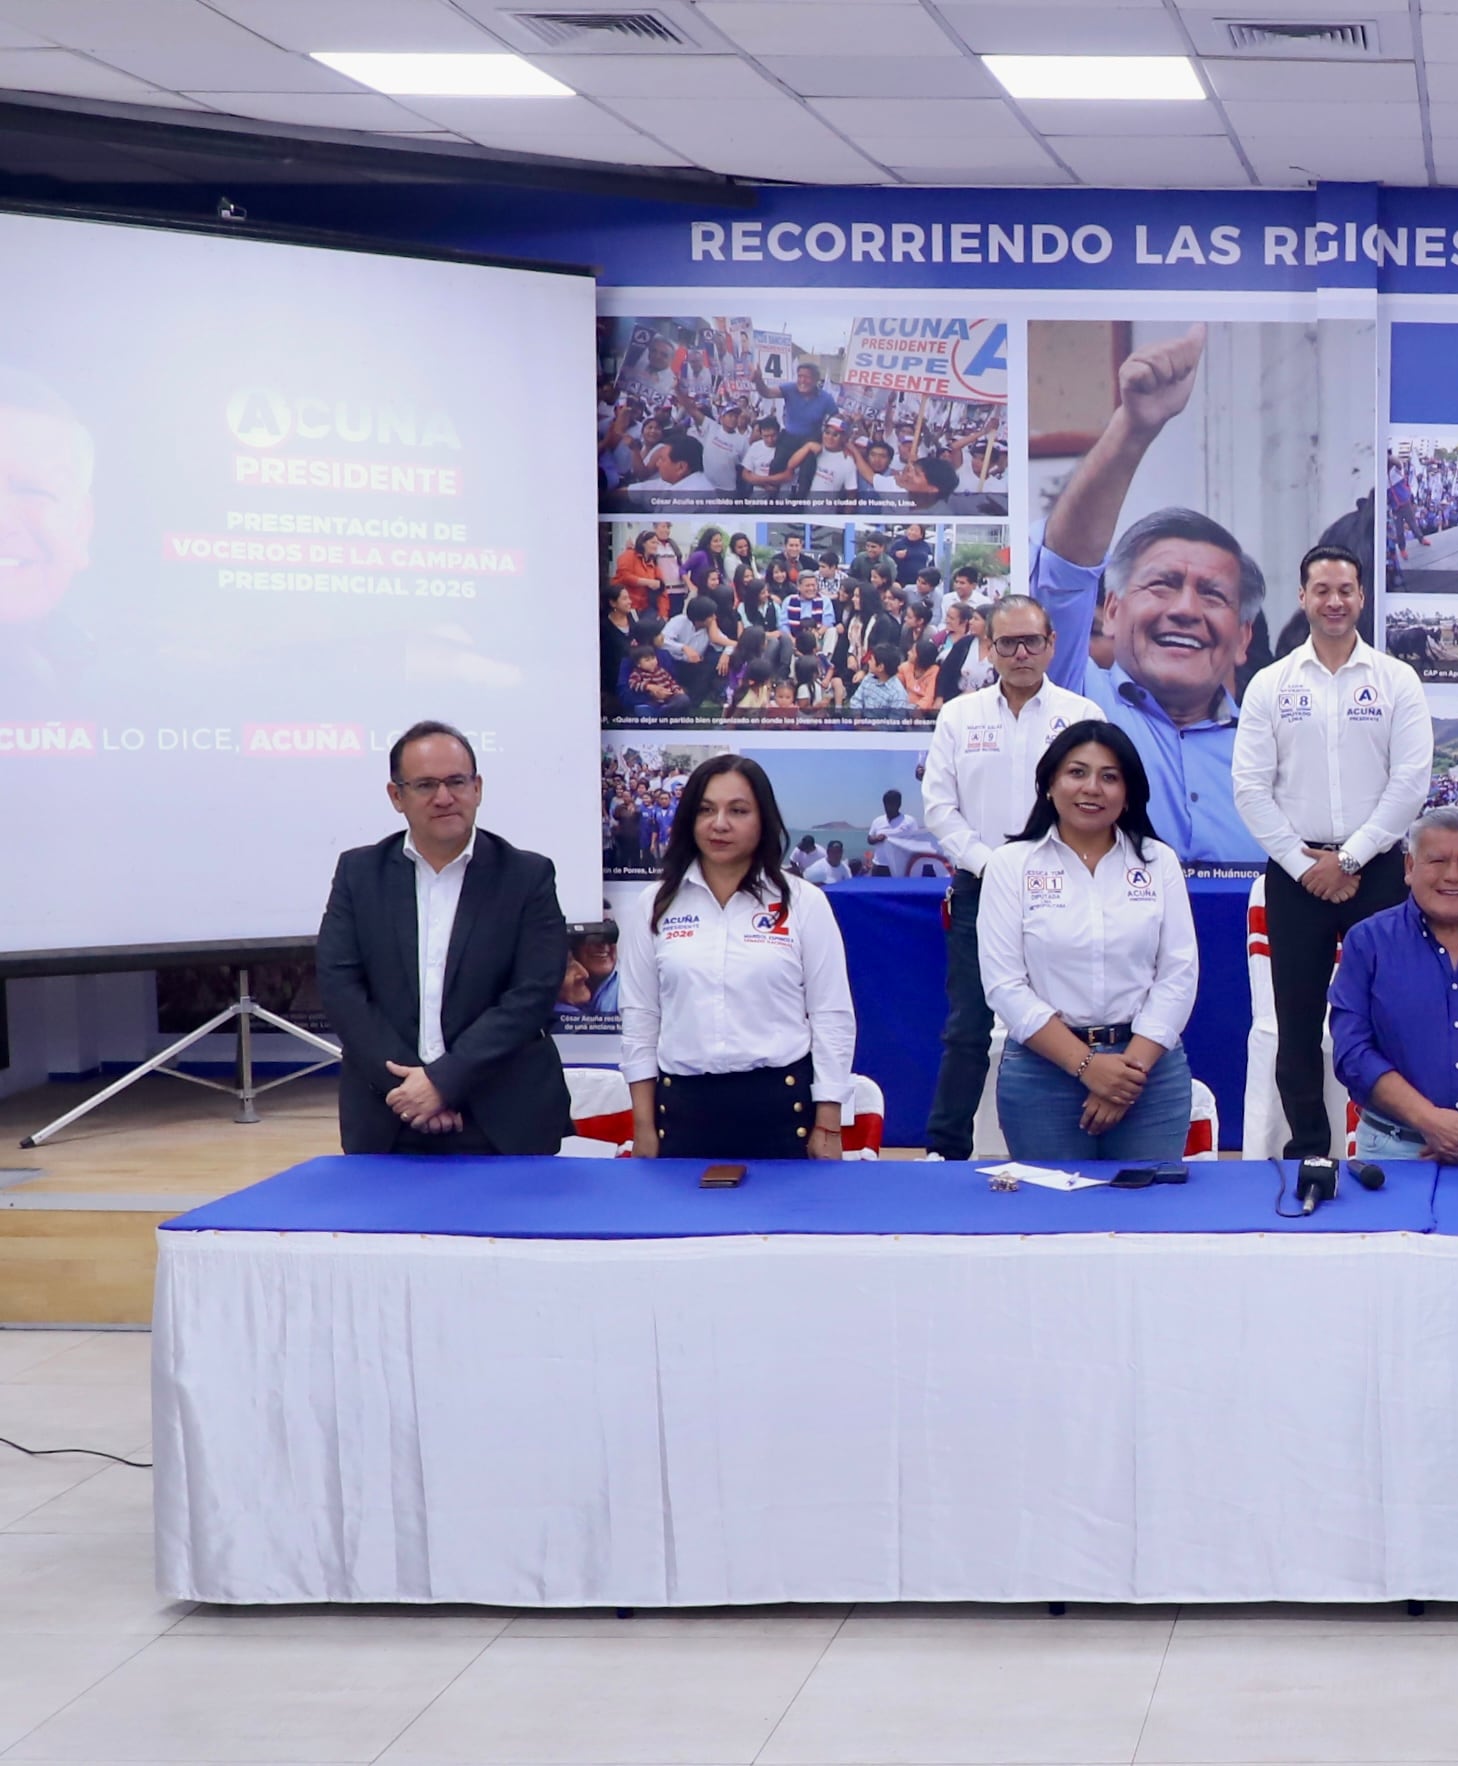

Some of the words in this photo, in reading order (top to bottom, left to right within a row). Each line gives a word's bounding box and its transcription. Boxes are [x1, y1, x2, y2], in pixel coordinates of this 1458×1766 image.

[691, 221, 1113, 265] RECORRIENDO
[1136, 224, 1242, 266] LAS
[861, 338, 947, 354] PRESIDENTE
[765, 354, 783, 378] 4
[855, 353, 949, 374] SUPE
[849, 369, 950, 394] PRESENTE
[234, 456, 457, 495] PRESIDENTE
[226, 511, 427, 539] PRESENTACIÓN
[434, 523, 467, 542] DE
[171, 537, 303, 563] VOCEROS
[309, 542, 345, 564] DE
[350, 545, 384, 566] LA
[390, 547, 516, 574] CAMPAÑA
[217, 569, 410, 597] PRESIDENCIAL
[415, 579, 477, 598] 2026
[1300, 696, 1308, 706] 8
[1359, 689, 1372, 701] A
[1347, 707, 1383, 716] ACUÑA
[0, 721, 92, 751] CUÑA
[103, 728, 144, 751] LO
[158, 728, 240, 754] DICE,
[250, 722, 360, 752] ACUÑA
[1133, 872, 1147, 884] A
[1197, 870, 1210, 878] en
[663, 914, 700, 925] ACUÑA
[665, 930, 694, 940] 2026
